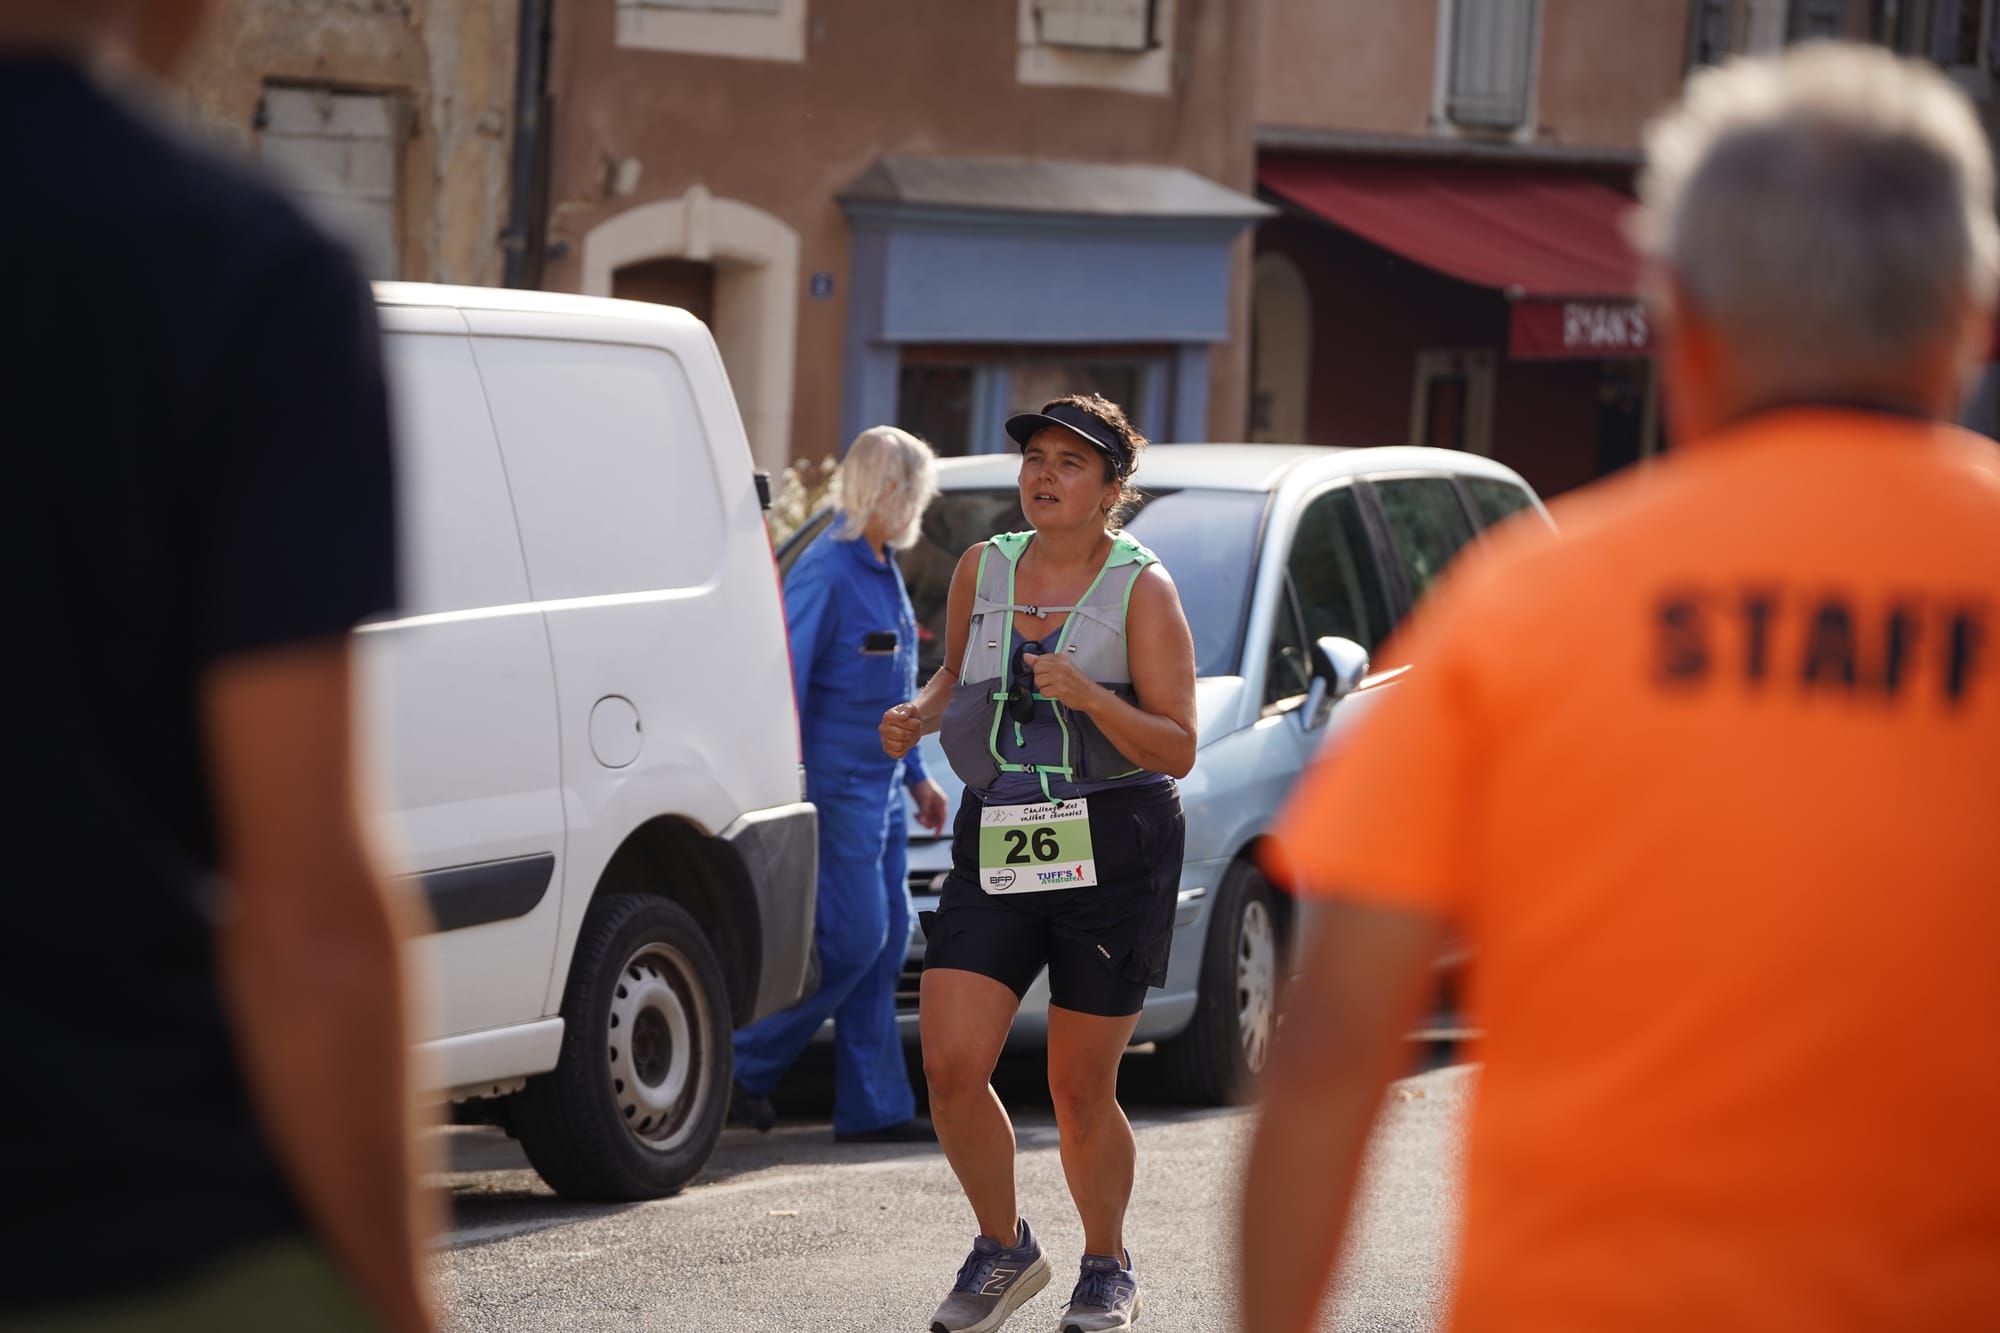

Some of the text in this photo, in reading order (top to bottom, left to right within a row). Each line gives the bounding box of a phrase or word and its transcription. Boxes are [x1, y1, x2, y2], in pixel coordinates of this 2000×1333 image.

[1651, 588, 1988, 700] STAFF
[1065, 802, 1077, 810] des
[1004, 827, 1060, 864] 26
[990, 876, 1012, 884] BFP
[1037, 870, 1073, 880] TUFF'S
